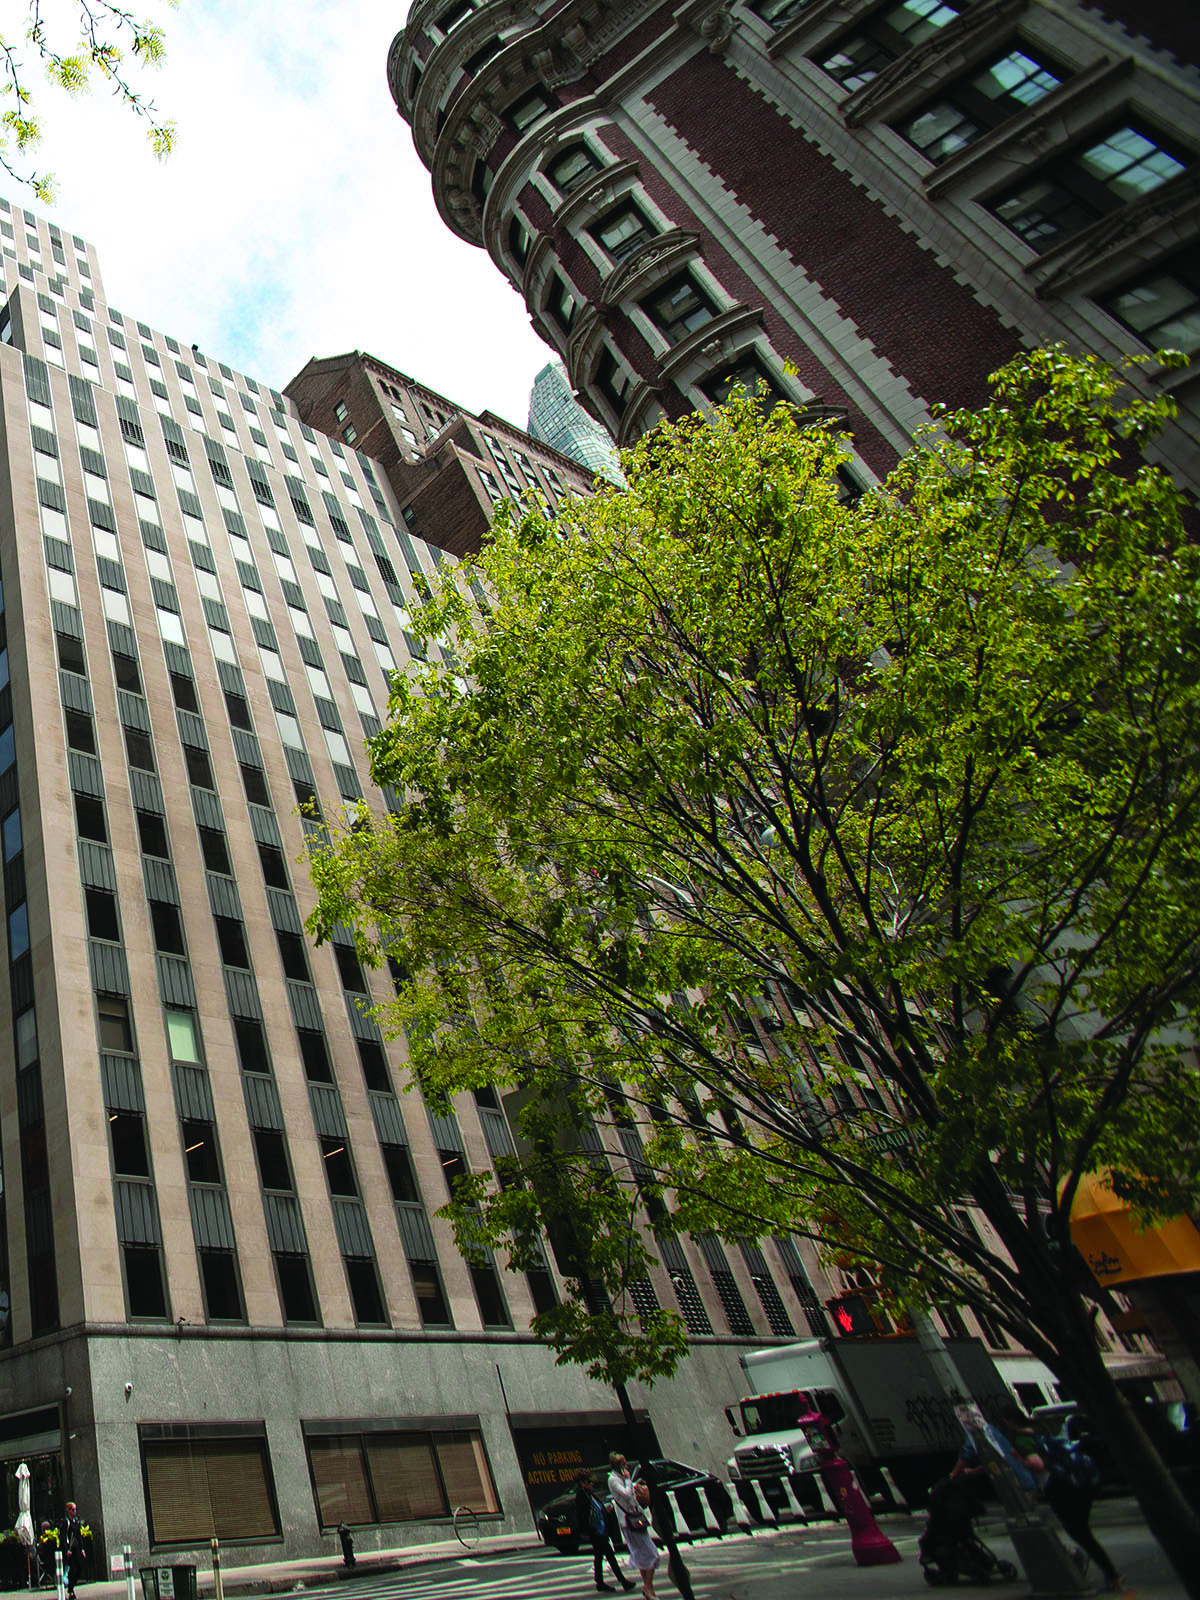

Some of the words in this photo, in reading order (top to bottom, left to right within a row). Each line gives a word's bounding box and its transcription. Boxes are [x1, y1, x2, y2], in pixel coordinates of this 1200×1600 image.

[533, 1452, 546, 1466] NO
[547, 1450, 582, 1465] PARKING
[528, 1469, 558, 1484] ACTIVE
